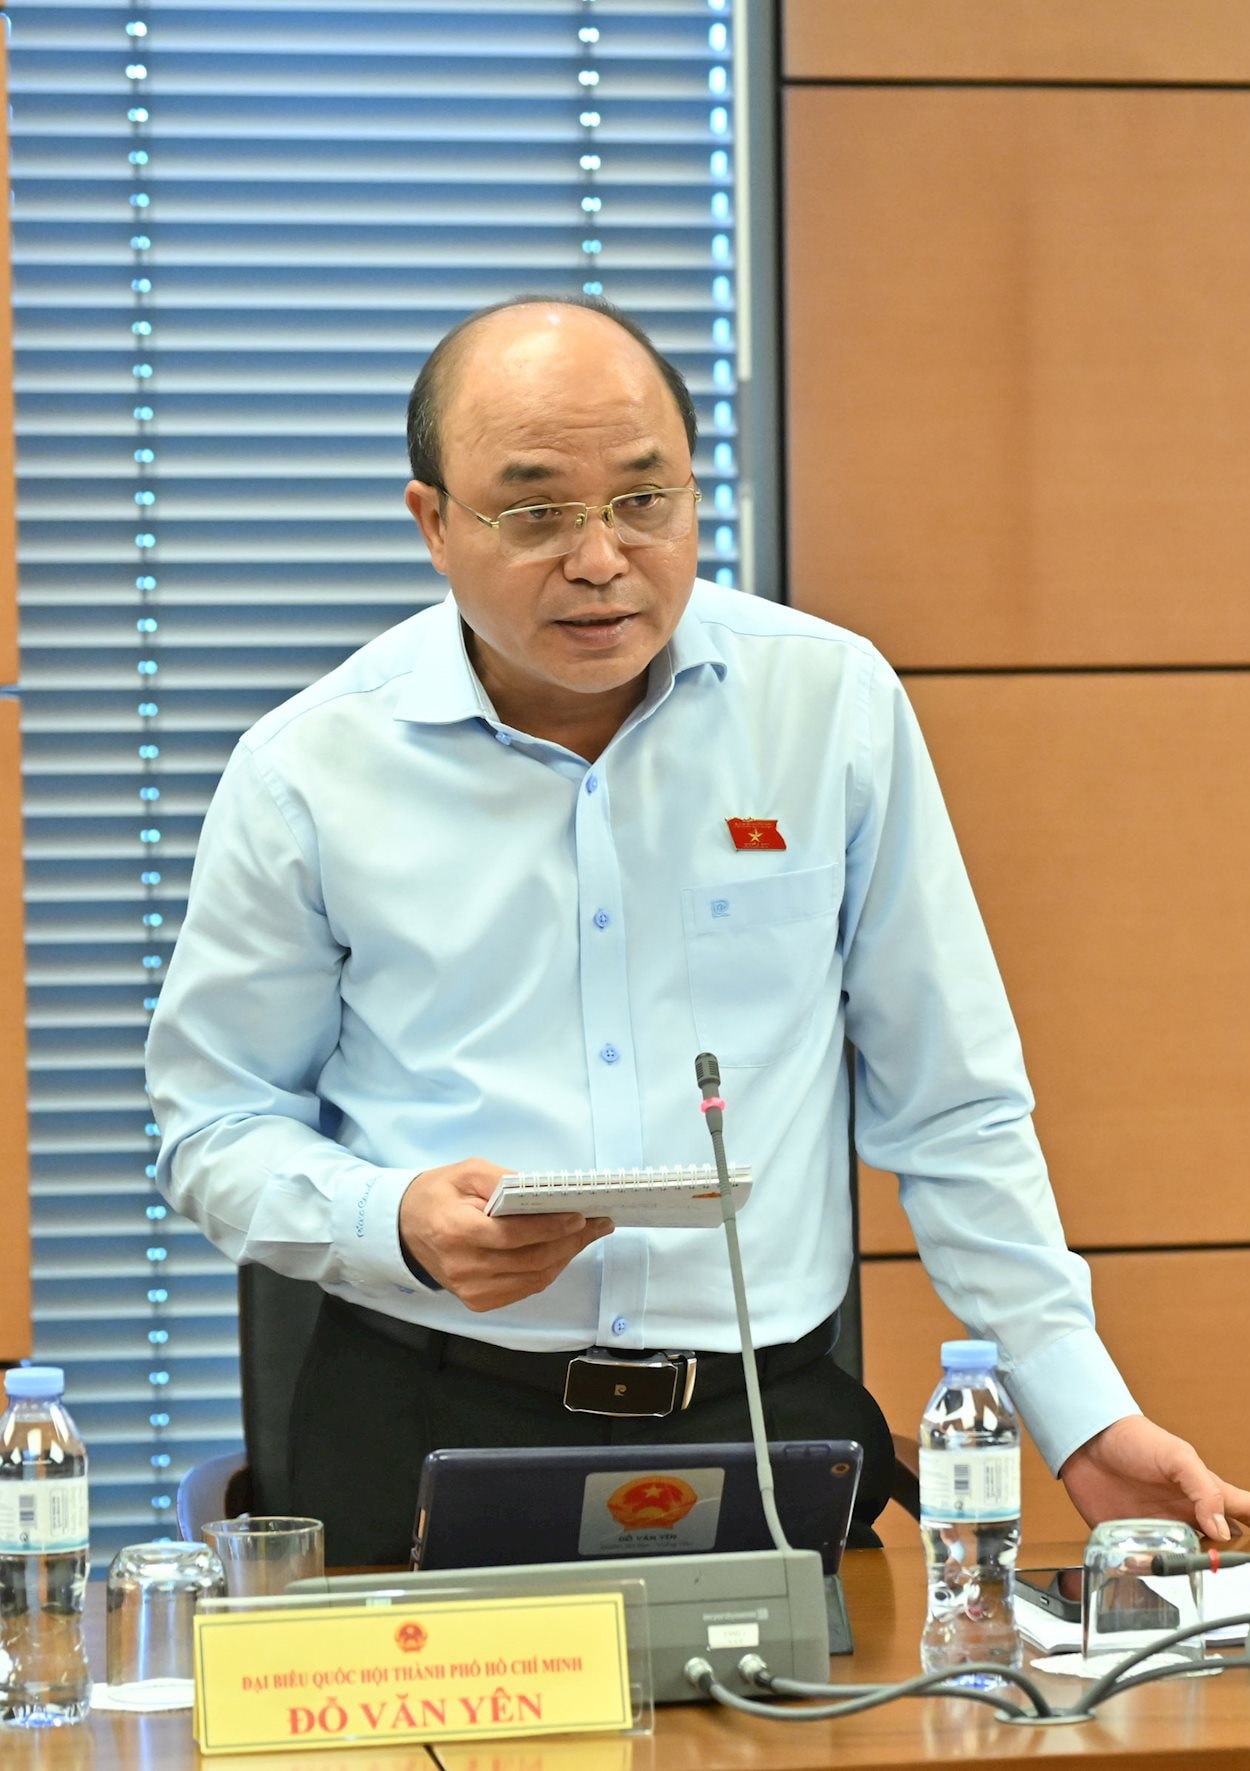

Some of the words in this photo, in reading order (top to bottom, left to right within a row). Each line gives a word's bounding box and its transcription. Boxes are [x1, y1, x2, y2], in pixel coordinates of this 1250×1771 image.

[242, 1675, 269, 1693] ĐẠI
[273, 1669, 308, 1689] BIỂU
[312, 1667, 356, 1690] QUỐC
[361, 1666, 389, 1686] HỘI
[393, 1662, 446, 1682] THÀNH
[450, 1659, 482, 1678] PHỐ
[485, 1658, 508, 1677] HỒ
[511, 1655, 538, 1675] CHÍ
[542, 1656, 583, 1673] MINH
[288, 1696, 349, 1736] ĐỖ
[360, 1692, 447, 1729] VĂN
[458, 1686, 543, 1725] YÊN
